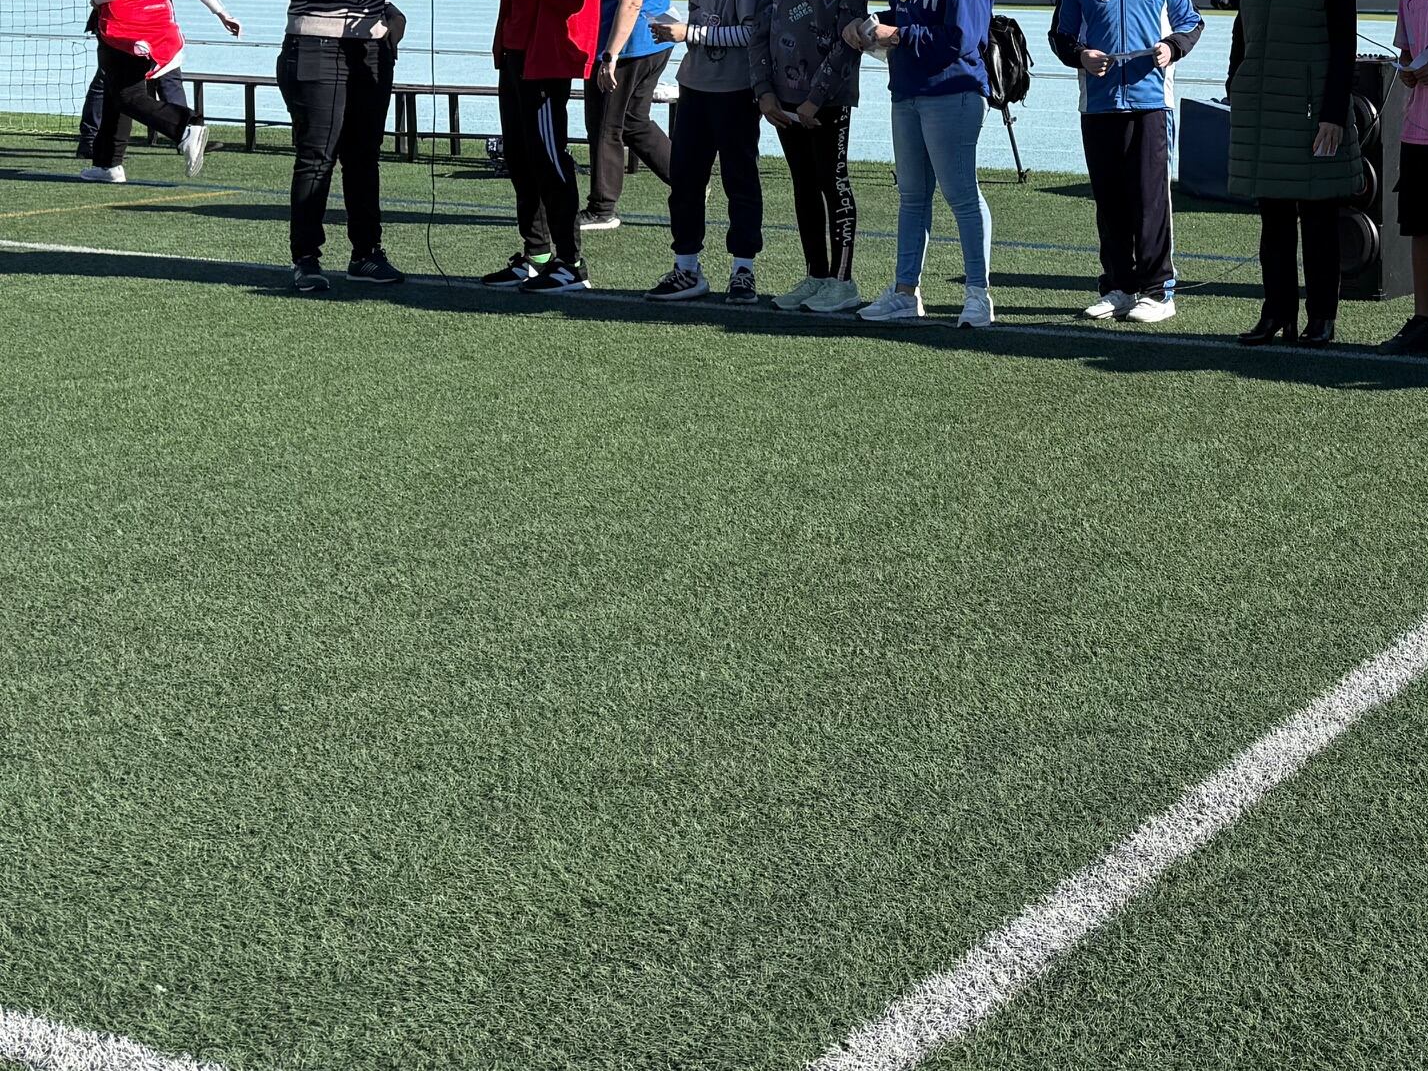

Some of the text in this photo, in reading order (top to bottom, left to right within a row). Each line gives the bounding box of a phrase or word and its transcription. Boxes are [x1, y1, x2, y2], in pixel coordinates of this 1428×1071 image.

[837, 127, 848, 160] have
[836, 162, 846, 174] a
[836, 197, 854, 213] of
